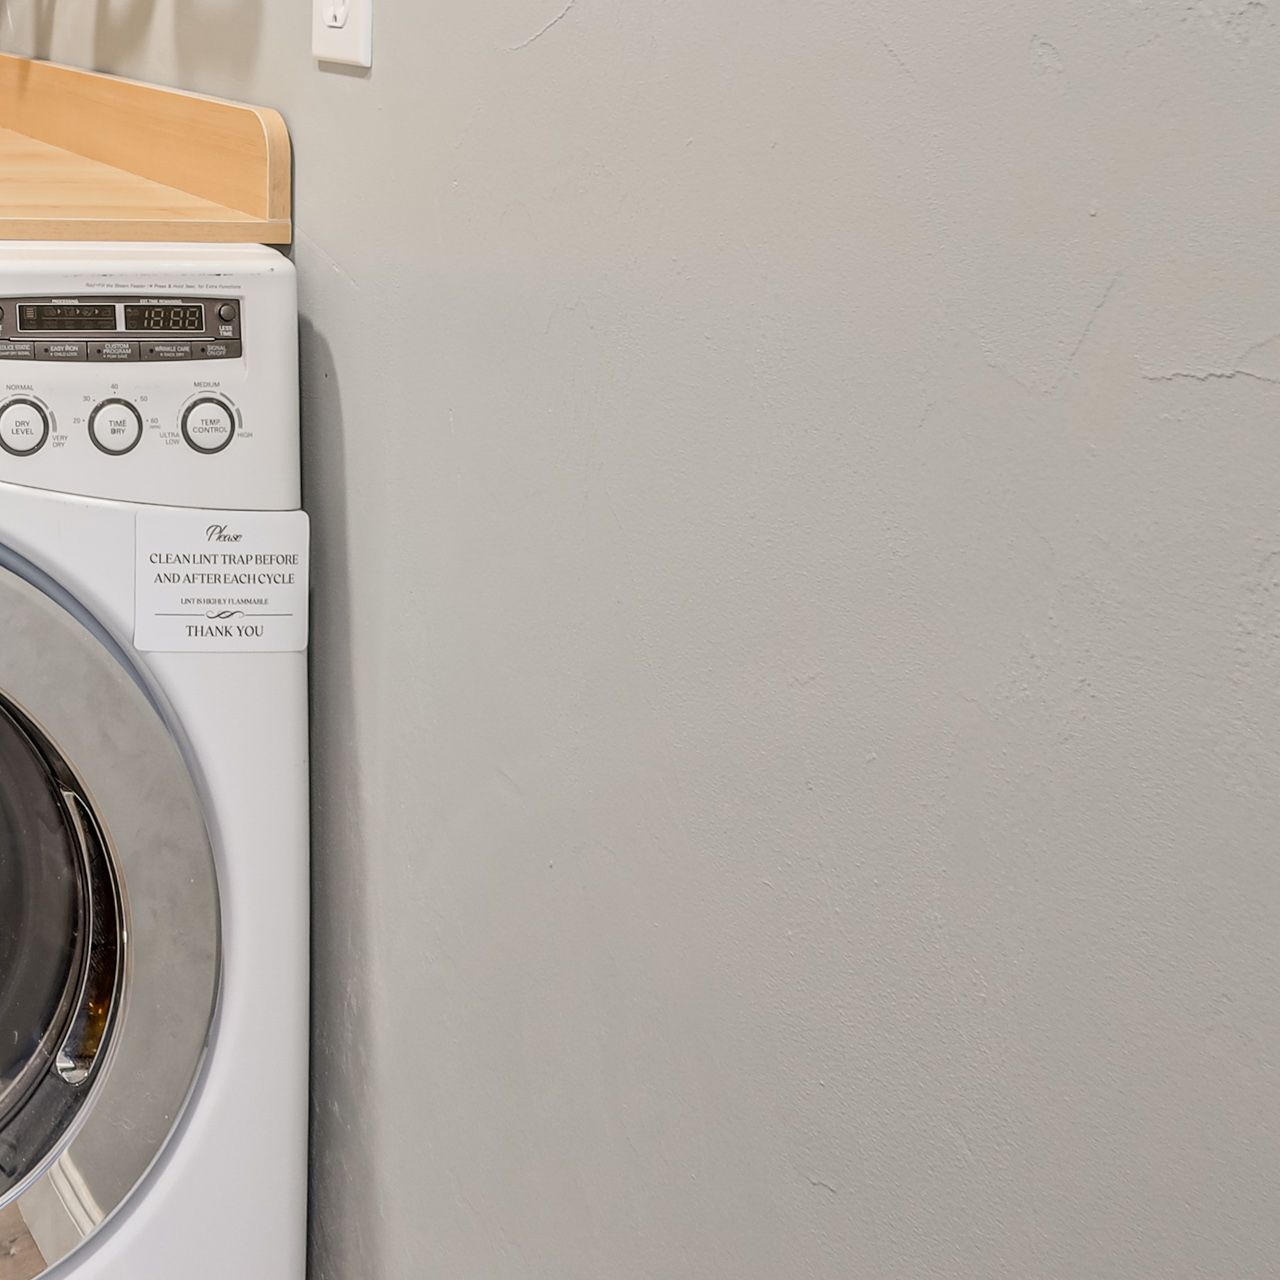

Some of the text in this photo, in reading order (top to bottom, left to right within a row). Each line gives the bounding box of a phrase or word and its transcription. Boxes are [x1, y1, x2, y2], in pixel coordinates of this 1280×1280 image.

[110, 427, 126, 435] DRY
[192, 426, 228, 434] CONTROL
[205, 524, 243, 543] Please
[149, 553, 299, 565] CLEAN LINT TRAP BEFORE
[154, 573, 295, 584] AND AFTER EACH CYCLE
[180, 597, 269, 605] LINT IS HIGHLY FLAMMABLE
[185, 624, 264, 637] THANK YOU
